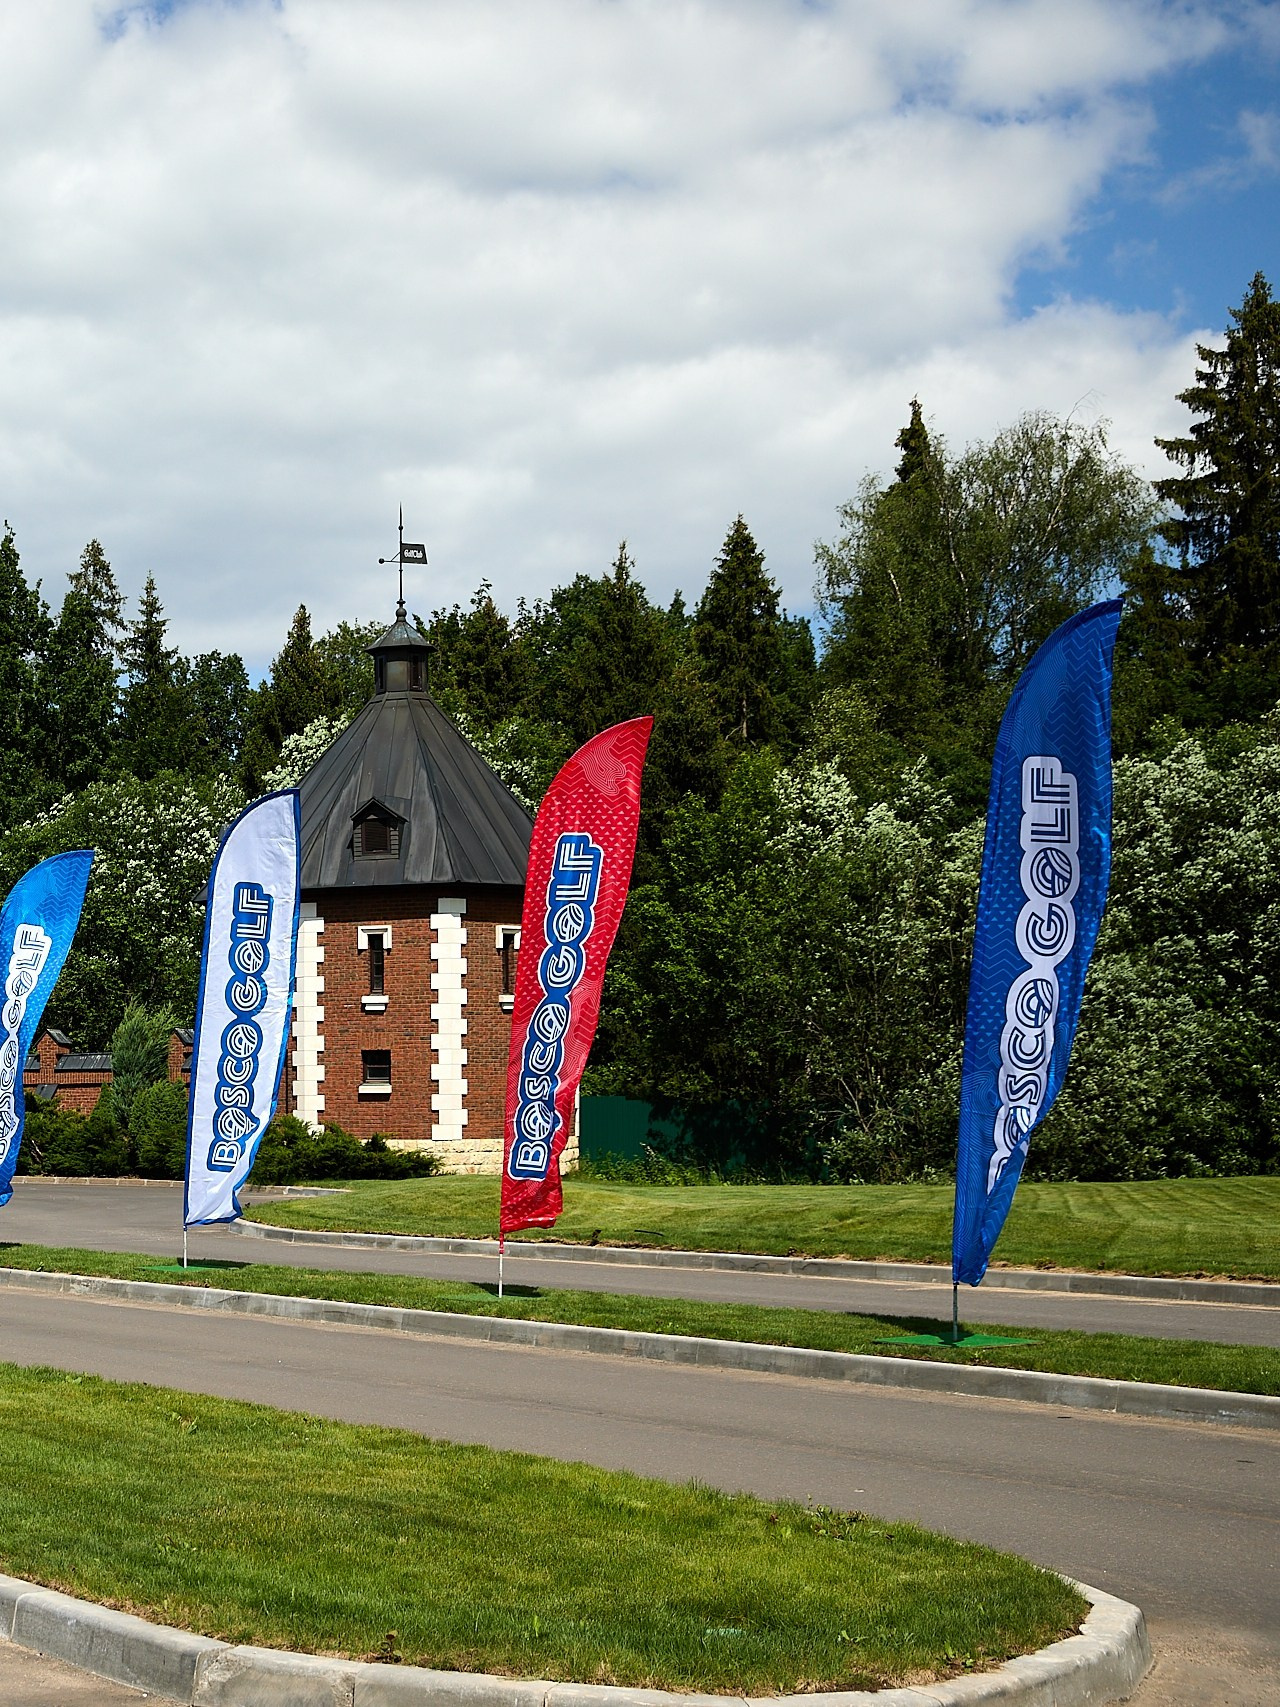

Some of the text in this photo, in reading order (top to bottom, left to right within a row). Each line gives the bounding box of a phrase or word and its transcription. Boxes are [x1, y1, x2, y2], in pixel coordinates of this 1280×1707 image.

[8, 928, 49, 1028] GOLF
[211, 887, 270, 1168] BOSCO GOLF
[516, 841, 596, 1178] BOSCO GOLF
[995, 767, 1072, 1181] OSCO GOLF
